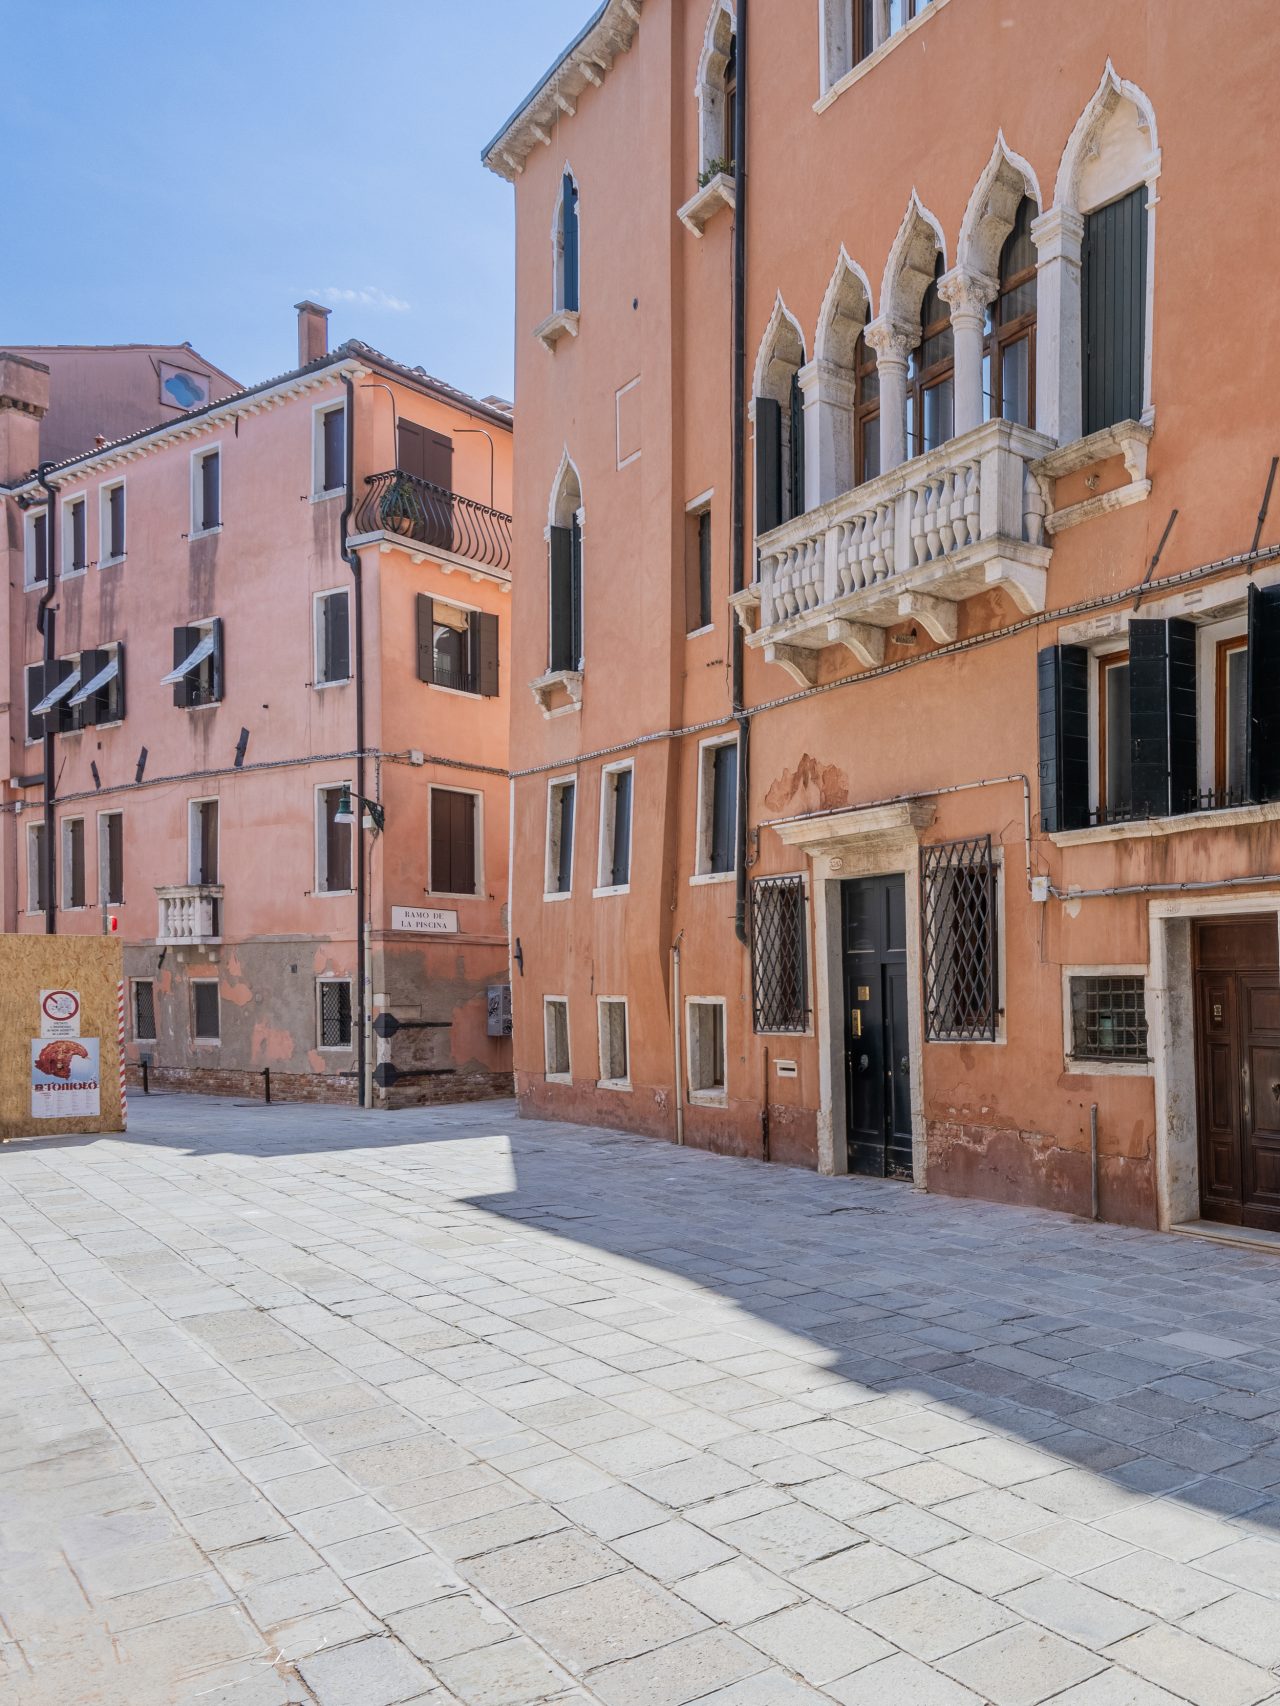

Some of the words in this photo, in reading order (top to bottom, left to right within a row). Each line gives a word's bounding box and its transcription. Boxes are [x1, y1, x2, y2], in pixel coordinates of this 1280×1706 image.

[404, 910, 430, 919] RAMO
[433, 912, 445, 920] DE
[401, 920, 412, 928] LA
[415, 921, 448, 929] PISCINA
